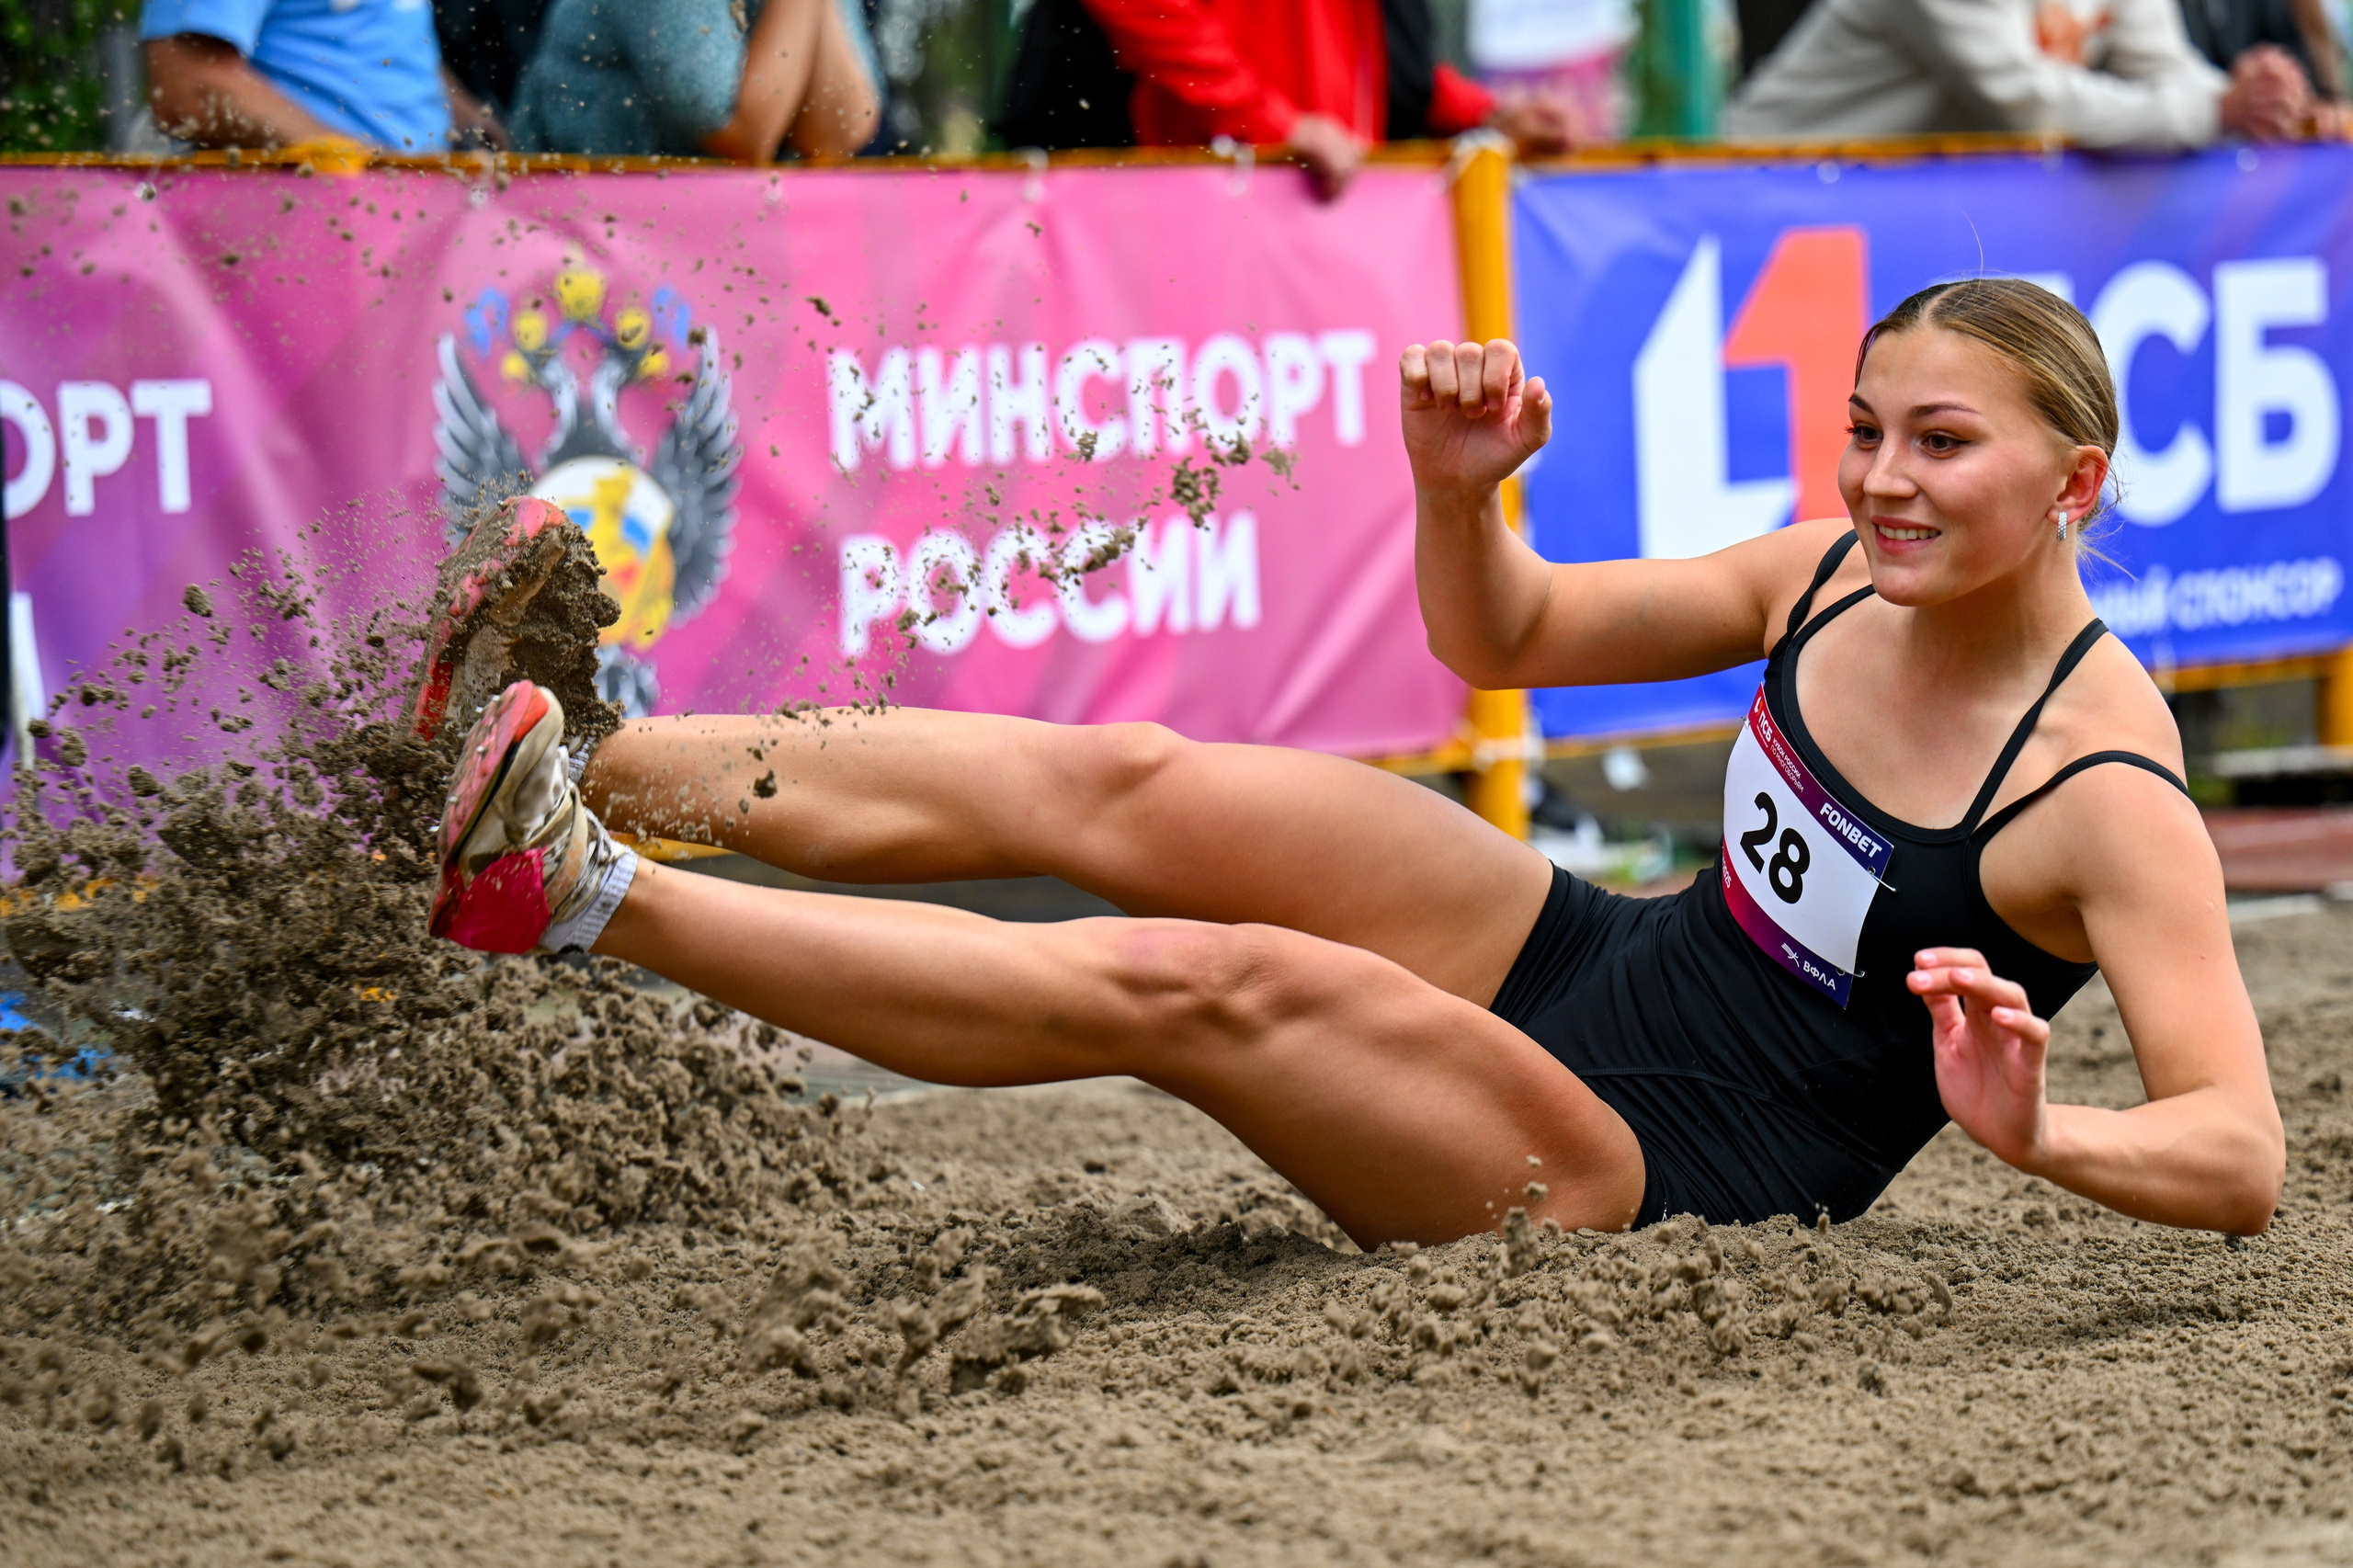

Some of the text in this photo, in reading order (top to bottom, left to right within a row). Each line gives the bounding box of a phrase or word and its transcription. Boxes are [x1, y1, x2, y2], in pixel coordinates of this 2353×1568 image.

[829, 328, 1376, 471] МИНСПОРТ
[2022, 258, 2342, 527] СБ
[838, 508, 1262, 657] РОССИИ
[1758, 710, 1773, 742] ПСБ
[1773, 738, 1802, 779] КУБОК РОССИИ
[1740, 791, 1810, 904] 28
[1820, 802, 1882, 858] FONBET
[1803, 960, 1836, 991] ВФЛА
